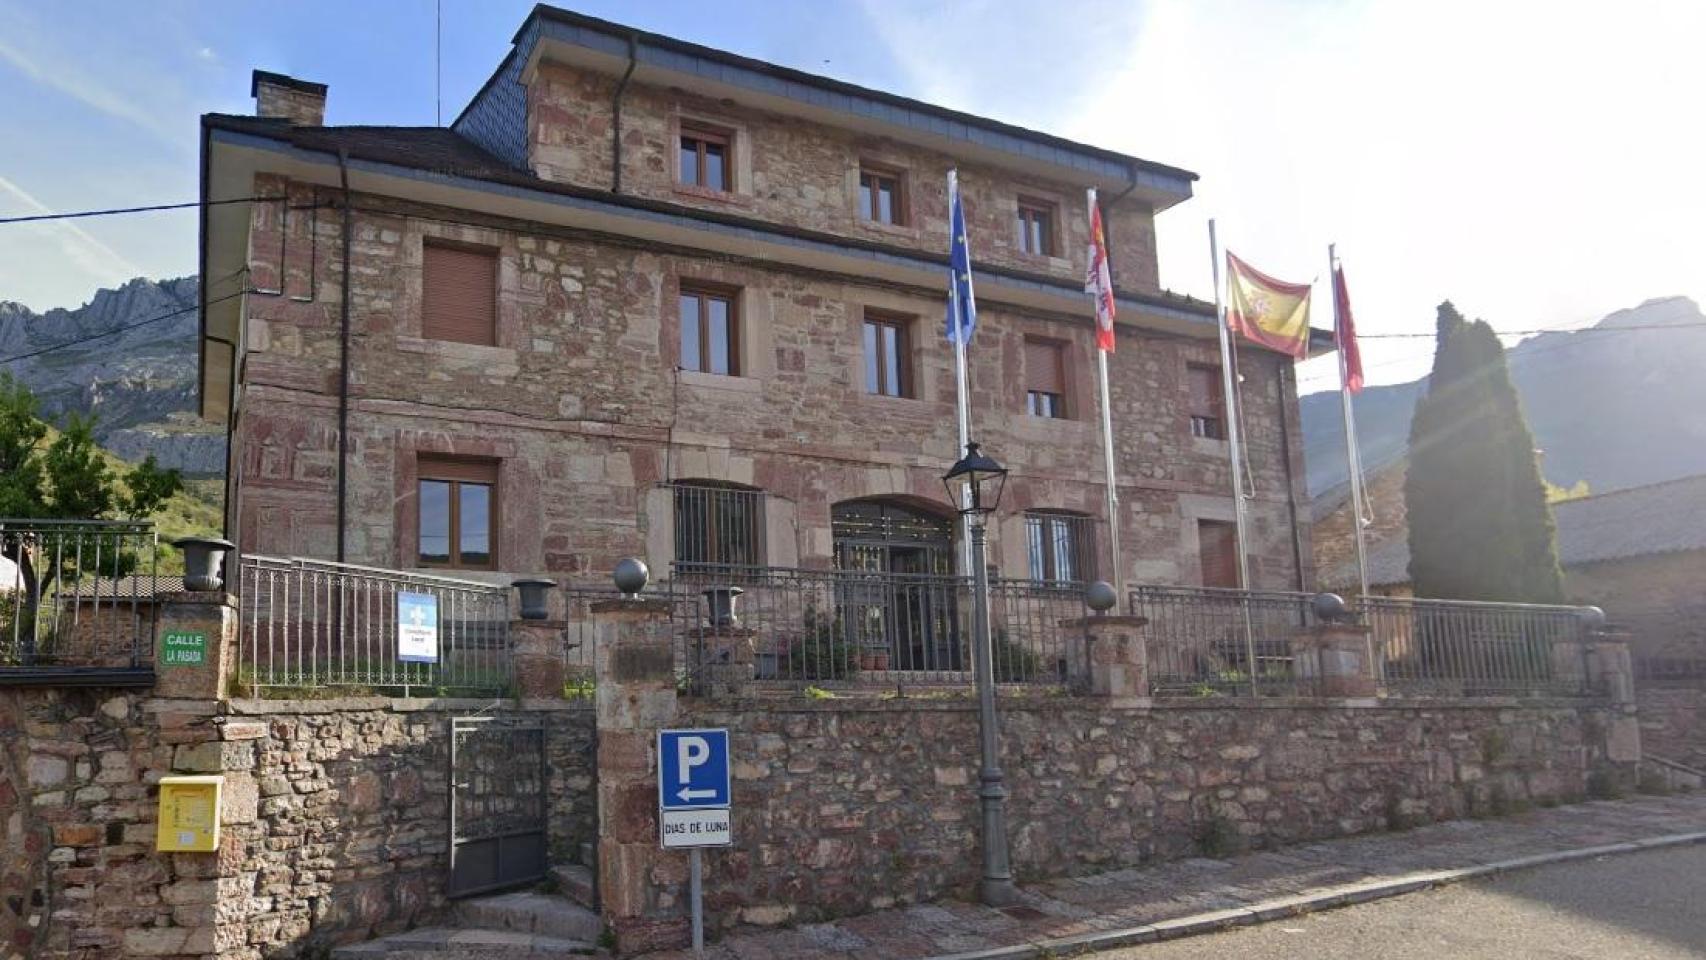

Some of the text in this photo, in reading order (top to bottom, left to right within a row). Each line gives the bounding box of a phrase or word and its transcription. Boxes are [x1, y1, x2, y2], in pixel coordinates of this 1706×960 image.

[166, 634, 204, 646] CALLE
[166, 650, 176, 662] LA
[677, 736, 710, 784] P
[690, 822, 702, 833] DE
[706, 821, 728, 832] LUNA
